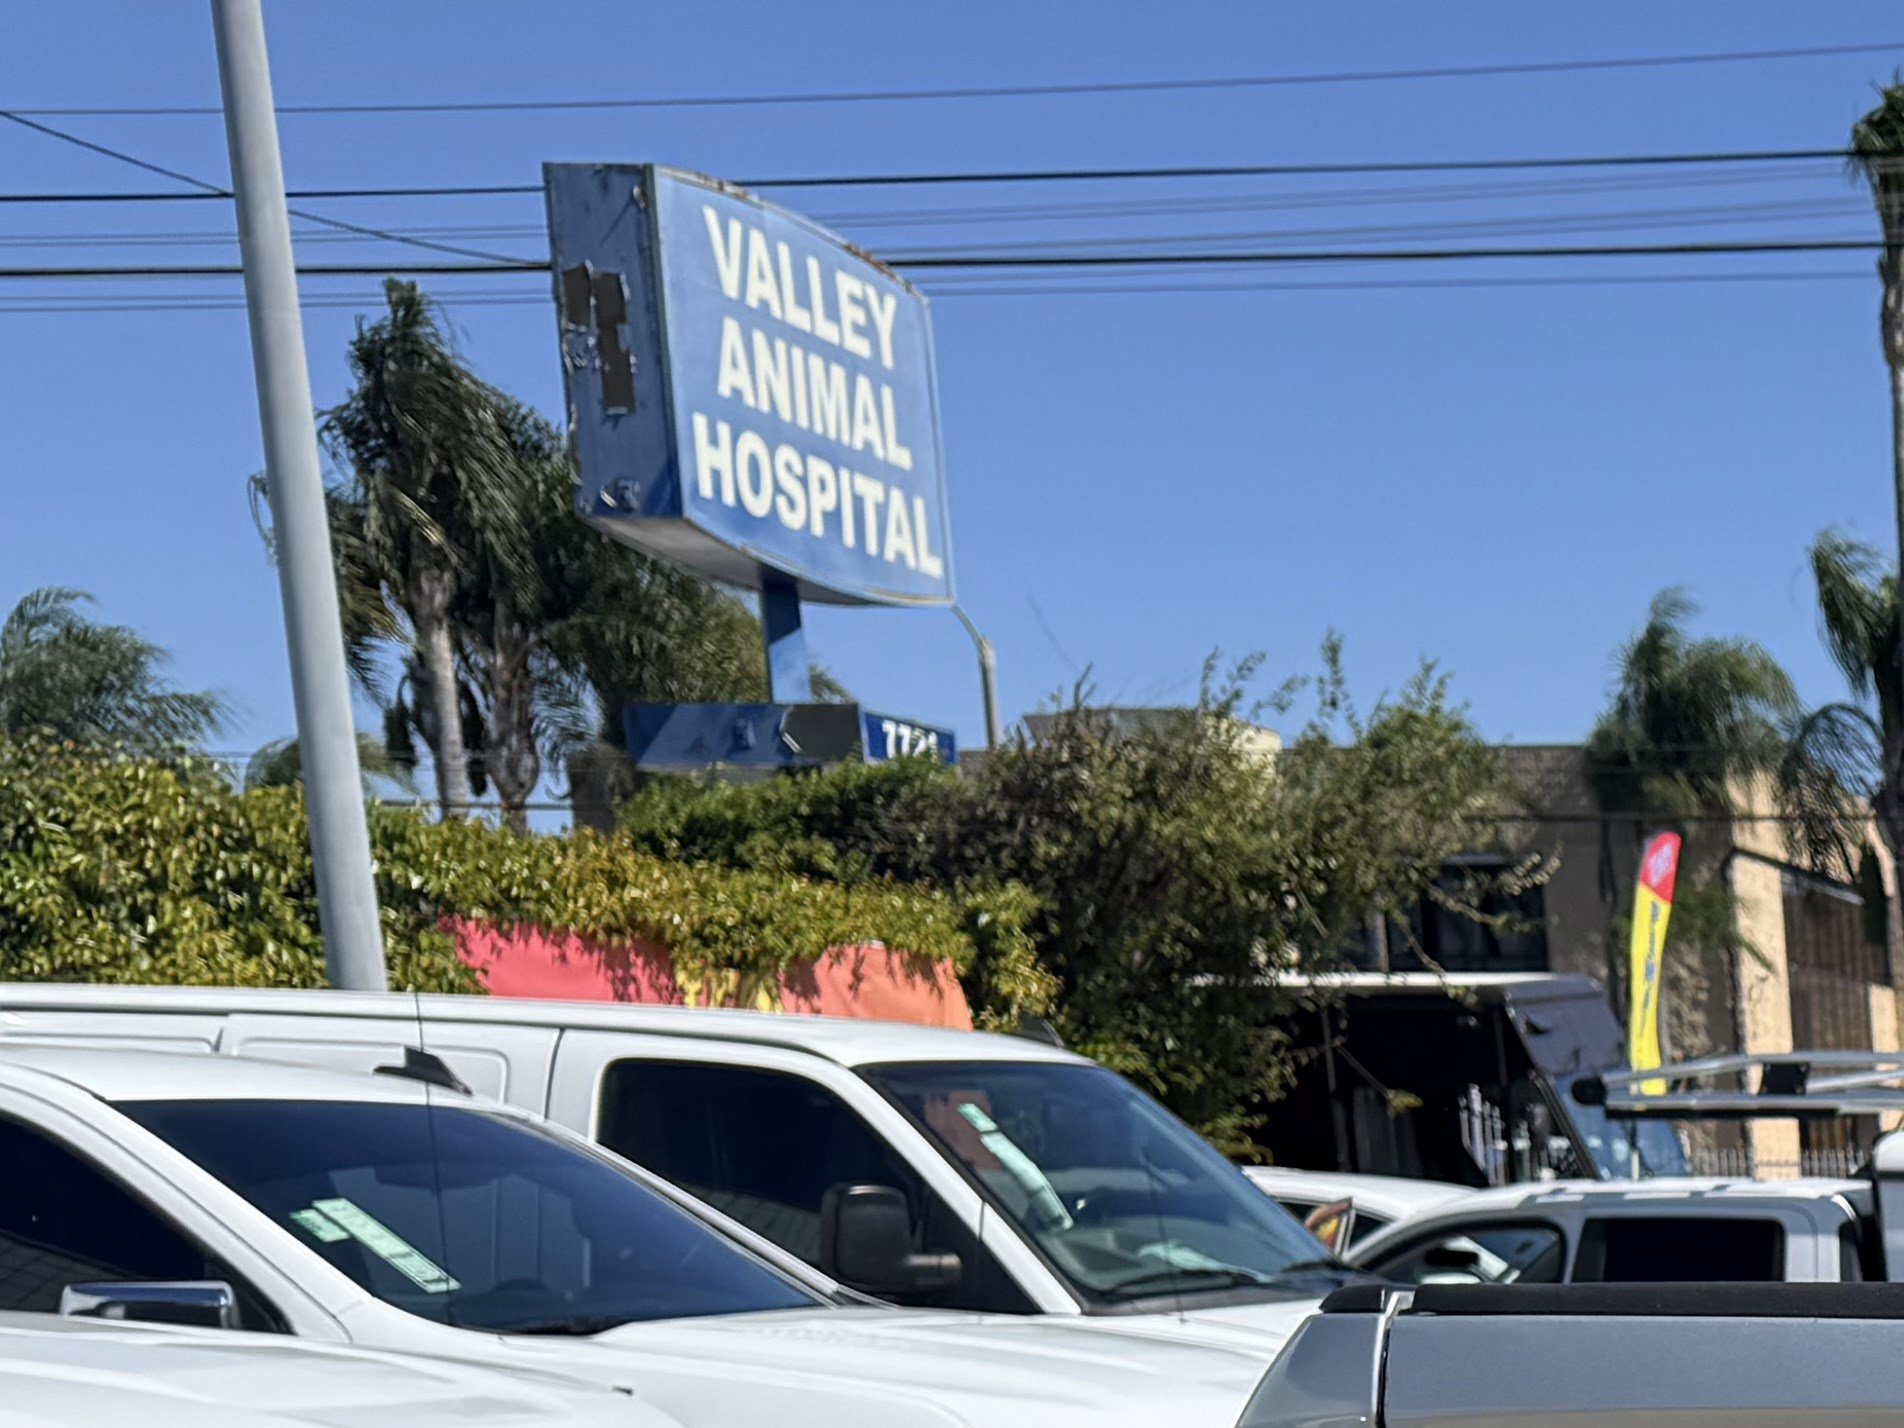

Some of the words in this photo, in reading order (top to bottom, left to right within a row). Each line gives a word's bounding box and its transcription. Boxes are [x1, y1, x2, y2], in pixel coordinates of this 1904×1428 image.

[703, 205, 897, 369] VALLEY
[718, 317, 912, 471] ANIMAL
[693, 412, 942, 578] HOSPITAL
